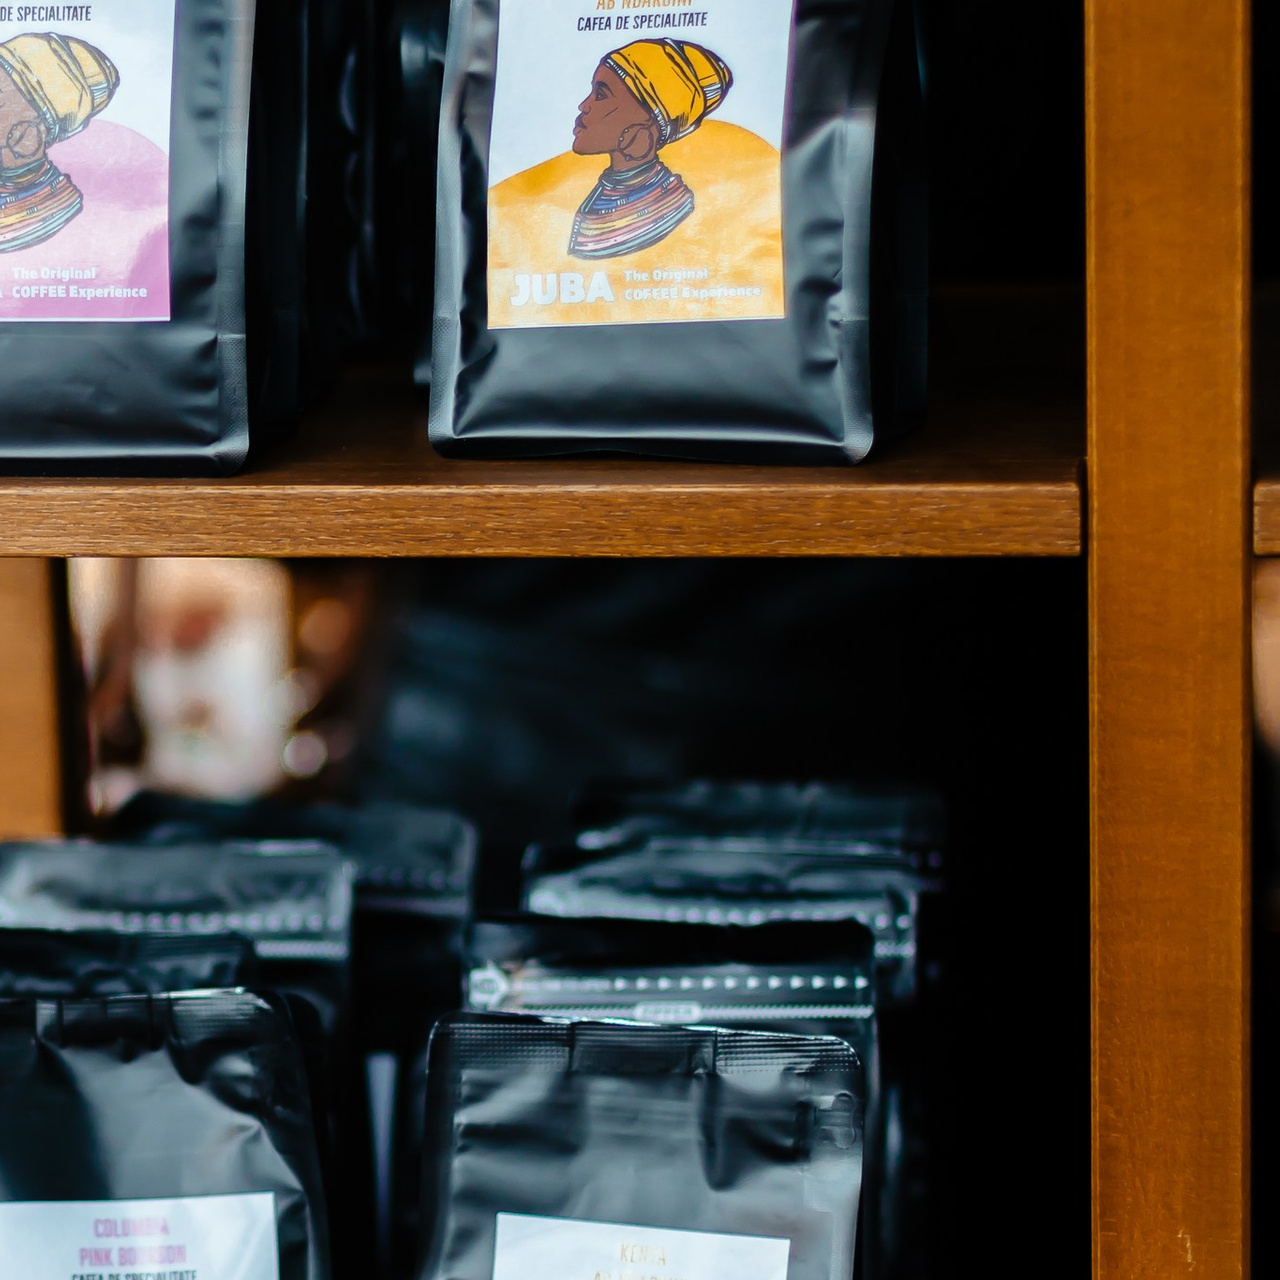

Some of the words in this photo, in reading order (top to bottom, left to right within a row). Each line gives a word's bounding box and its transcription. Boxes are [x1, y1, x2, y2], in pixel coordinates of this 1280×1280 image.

[0, 6, 13, 22] DE
[16, 5, 92, 22] SPECIALITATE
[576, 16, 612, 32] CAFEA
[615, 15, 630, 30] DE
[632, 11, 708, 30] SPECIALITATE
[12, 267, 38, 279] The
[40, 267, 96, 283] Original
[12, 285, 67, 298] COFFEE
[69, 285, 148, 301] Experience
[509, 271, 615, 307] JUBA
[623, 270, 649, 282] The
[651, 268, 709, 283] Original
[623, 287, 678, 301] COFFEE
[681, 286, 762, 301] Experience
[78, 1247, 113, 1267] PINK
[118, 1245, 187, 1267] BOBON
